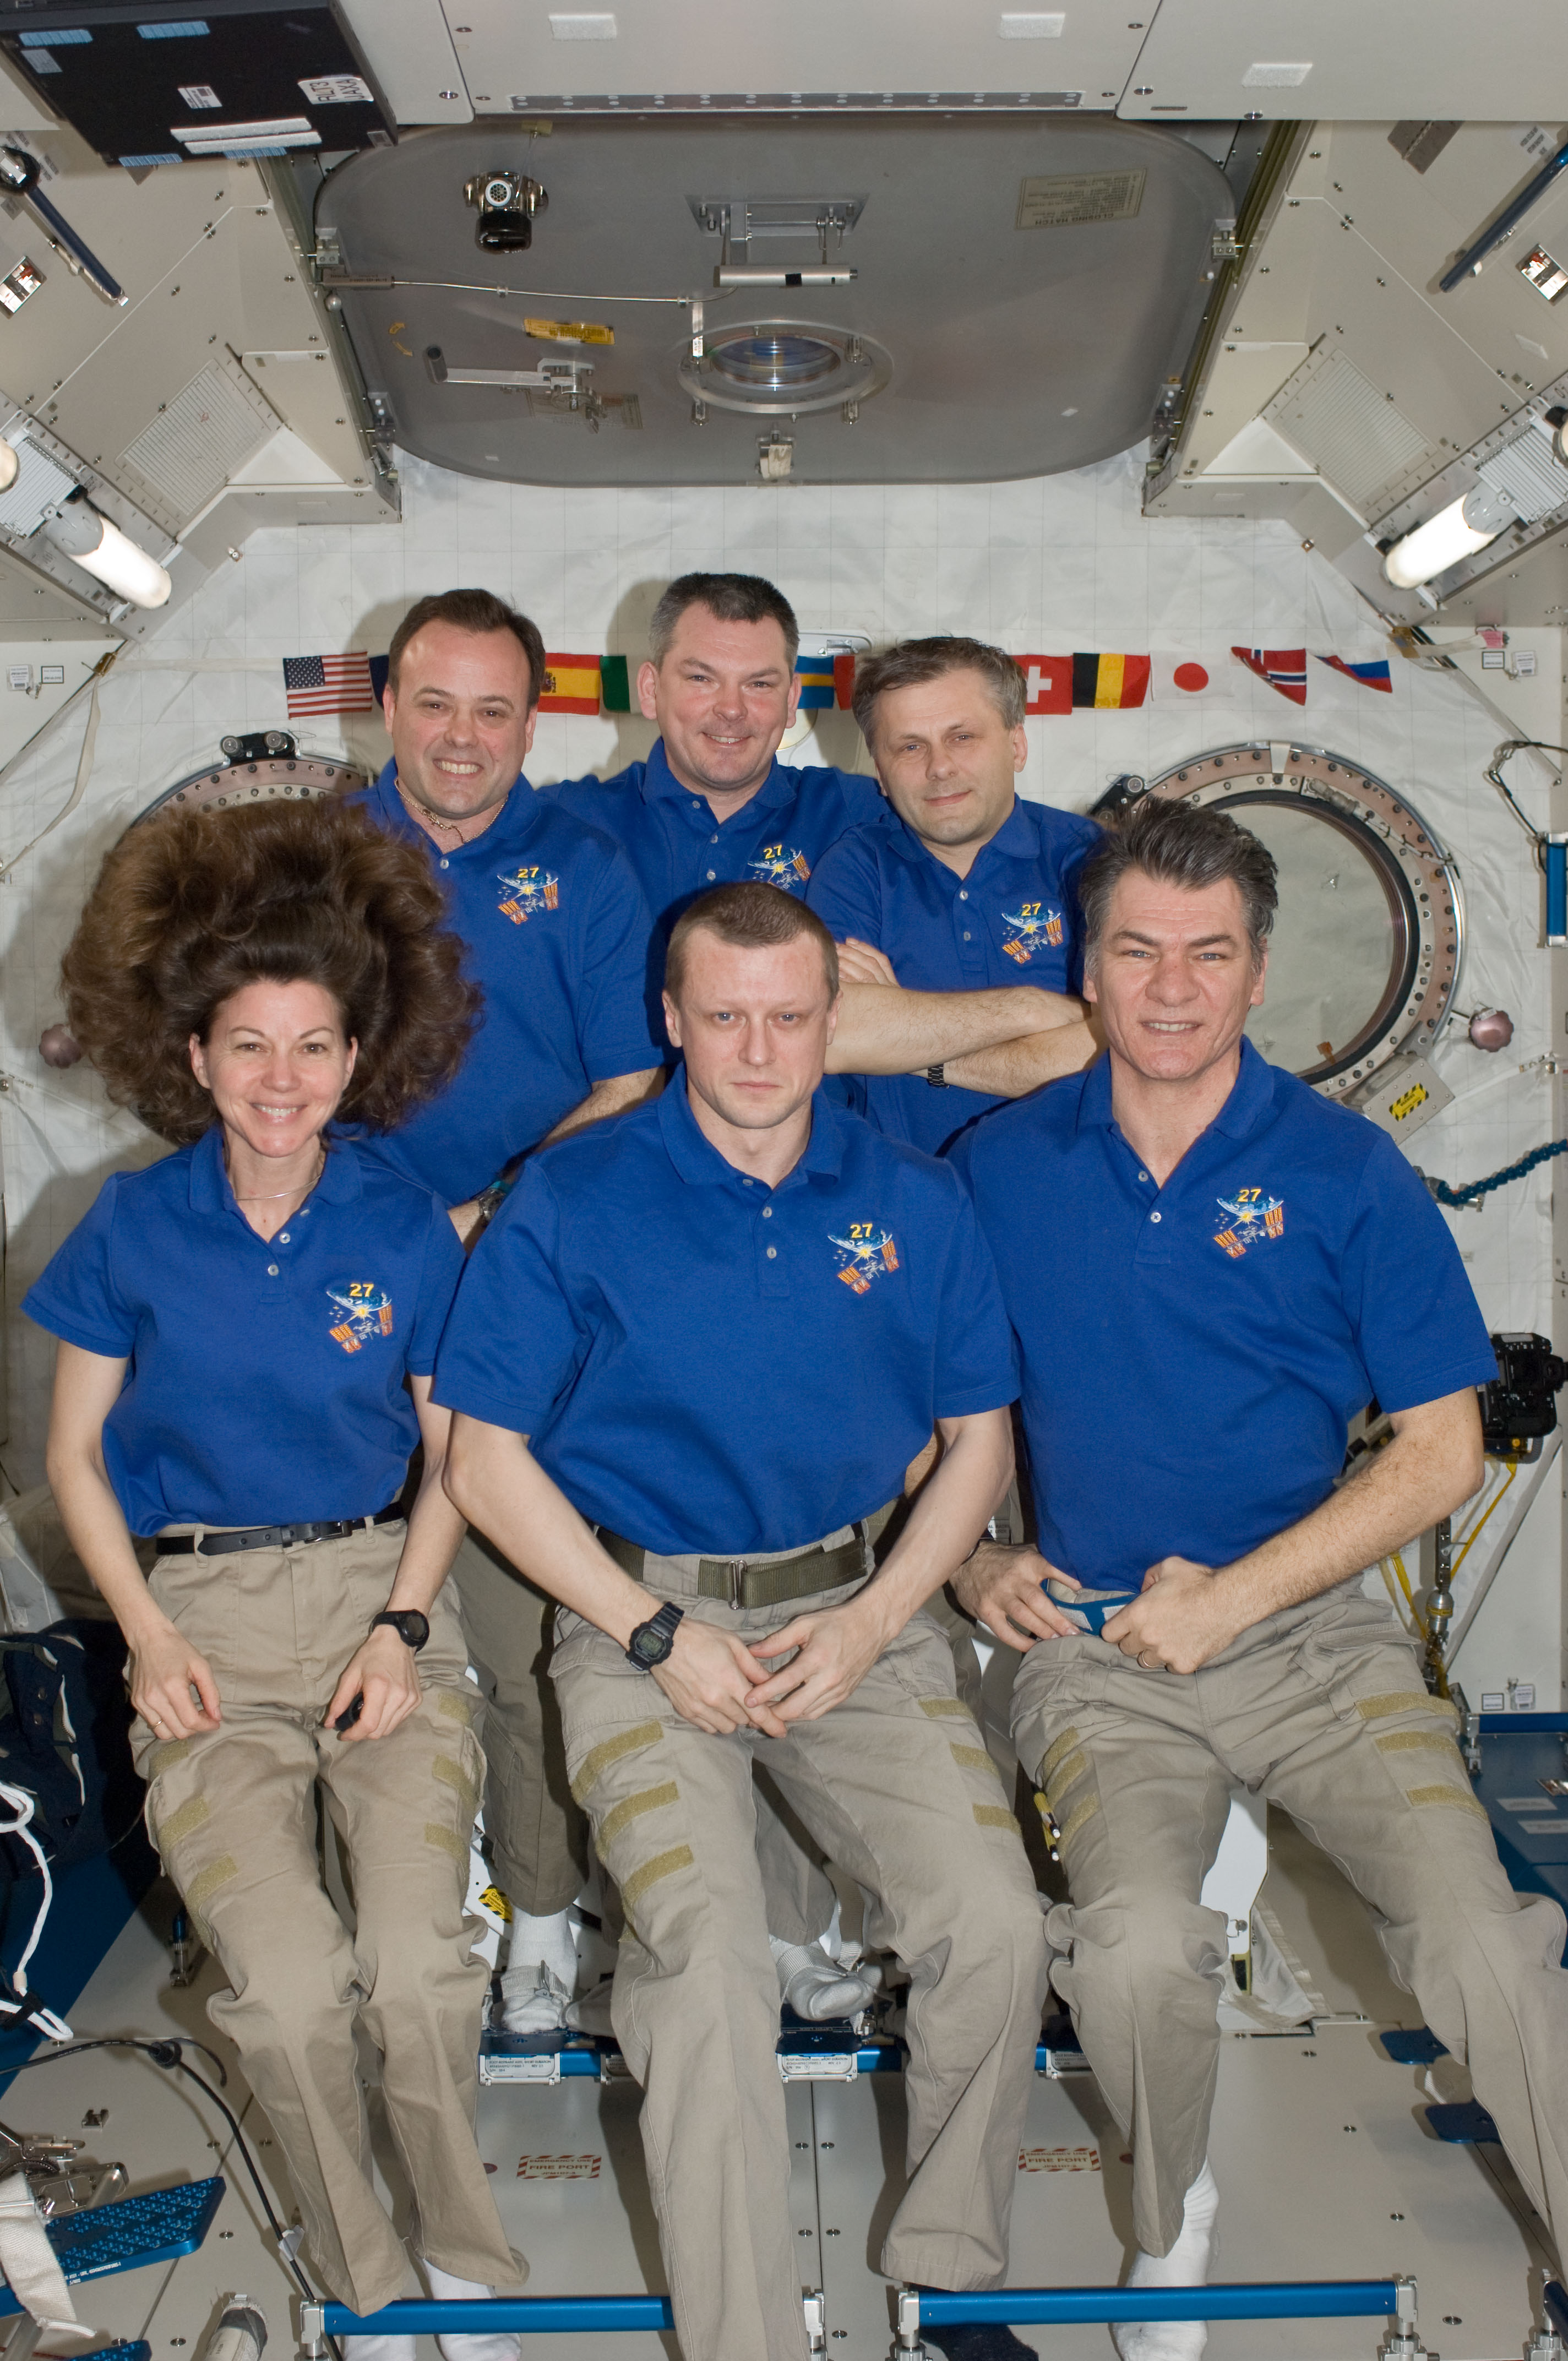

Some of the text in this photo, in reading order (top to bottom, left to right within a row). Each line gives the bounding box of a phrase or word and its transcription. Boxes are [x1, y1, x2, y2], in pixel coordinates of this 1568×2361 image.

[309, 81, 339, 102] RLT3
[336, 79, 366, 100] JAXA
[1071, 213, 1114, 222] CLOSING
[763, 845, 782, 858] 27
[518, 867, 539, 878] 27
[1021, 903, 1040, 916] 27
[1238, 1189, 1261, 1201] 27
[850, 1223, 872, 1238] 27
[350, 1283, 373, 1297] 27
